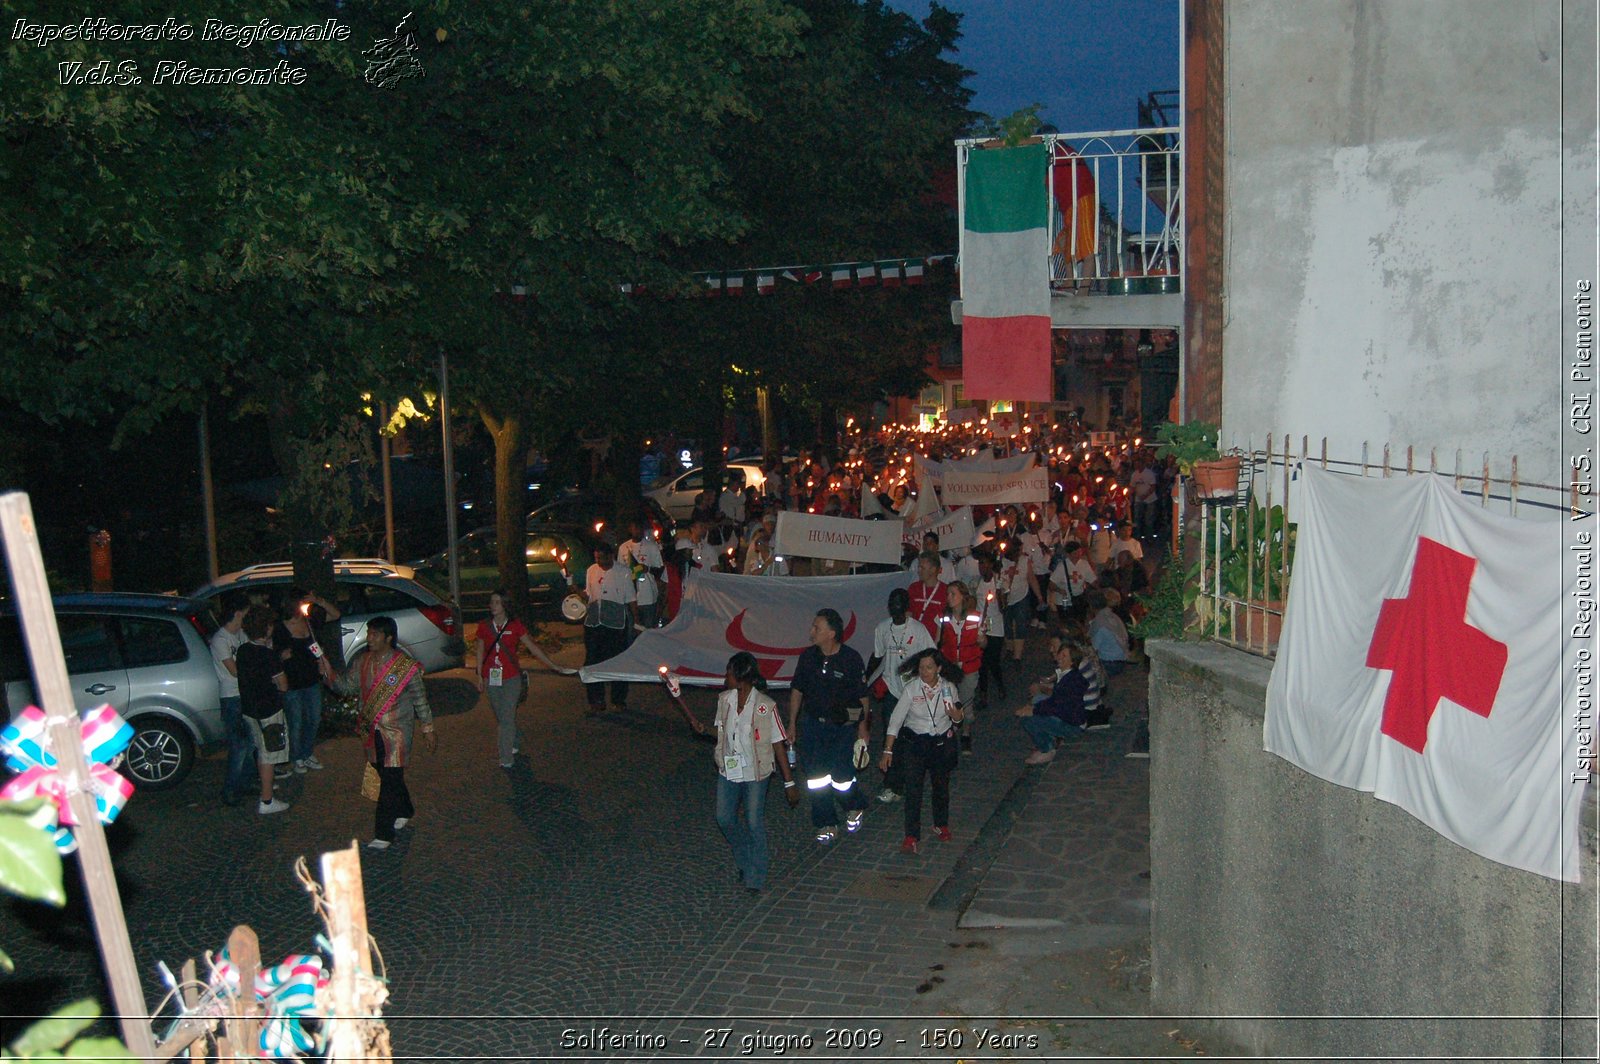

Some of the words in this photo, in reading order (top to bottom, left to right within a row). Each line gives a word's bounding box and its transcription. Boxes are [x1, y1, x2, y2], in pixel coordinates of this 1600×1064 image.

[946, 482, 1005, 495] VOLUNTARY
[1006, 479, 1047, 490] SERVICE
[807, 529, 872, 547] HUMANITY
